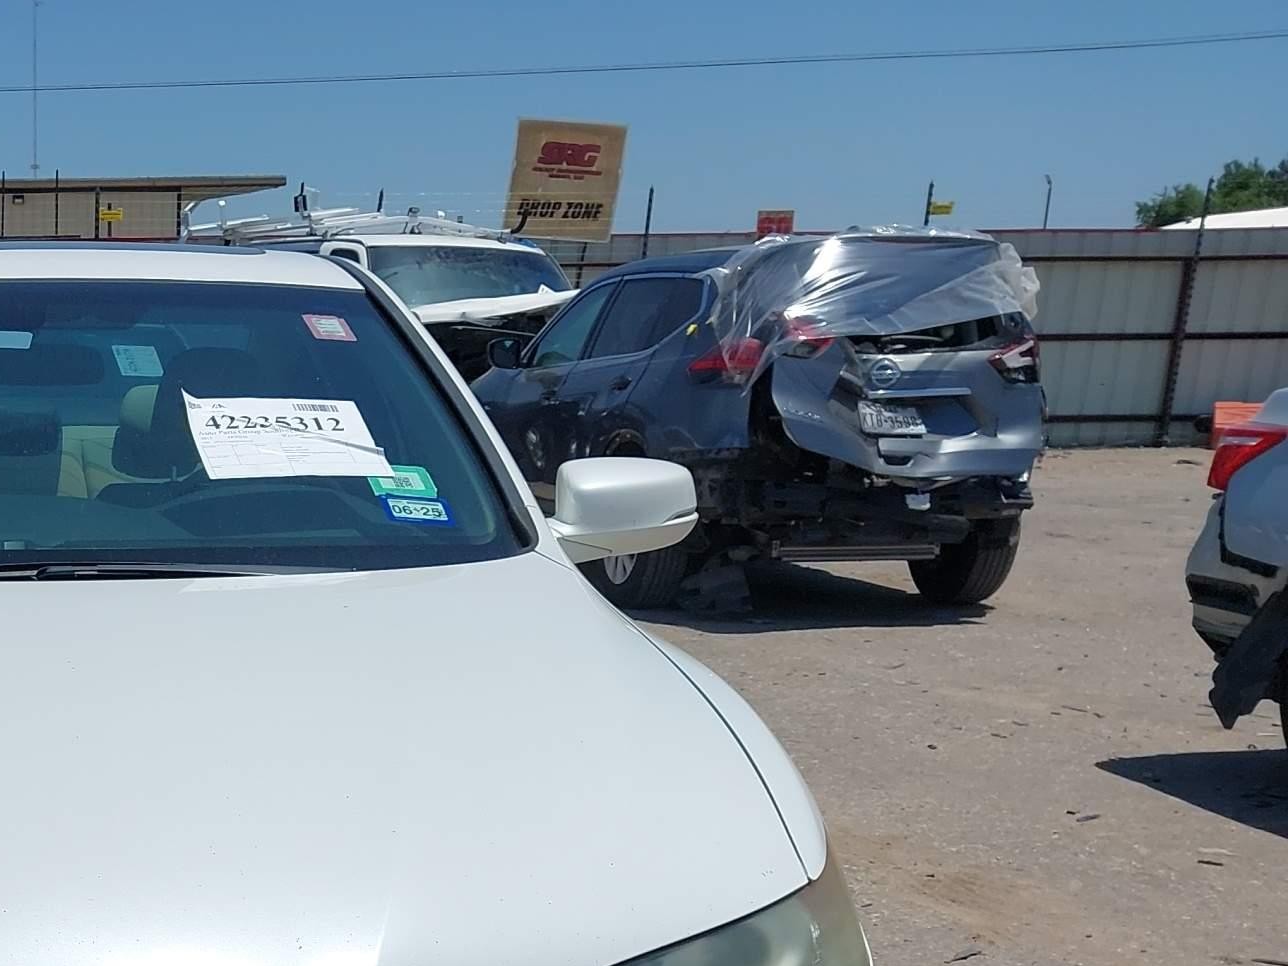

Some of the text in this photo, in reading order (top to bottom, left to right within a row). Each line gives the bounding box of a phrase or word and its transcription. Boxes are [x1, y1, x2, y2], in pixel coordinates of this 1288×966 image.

[537, 141, 601, 168] SRG
[517, 198, 604, 219] DROP ZONE
